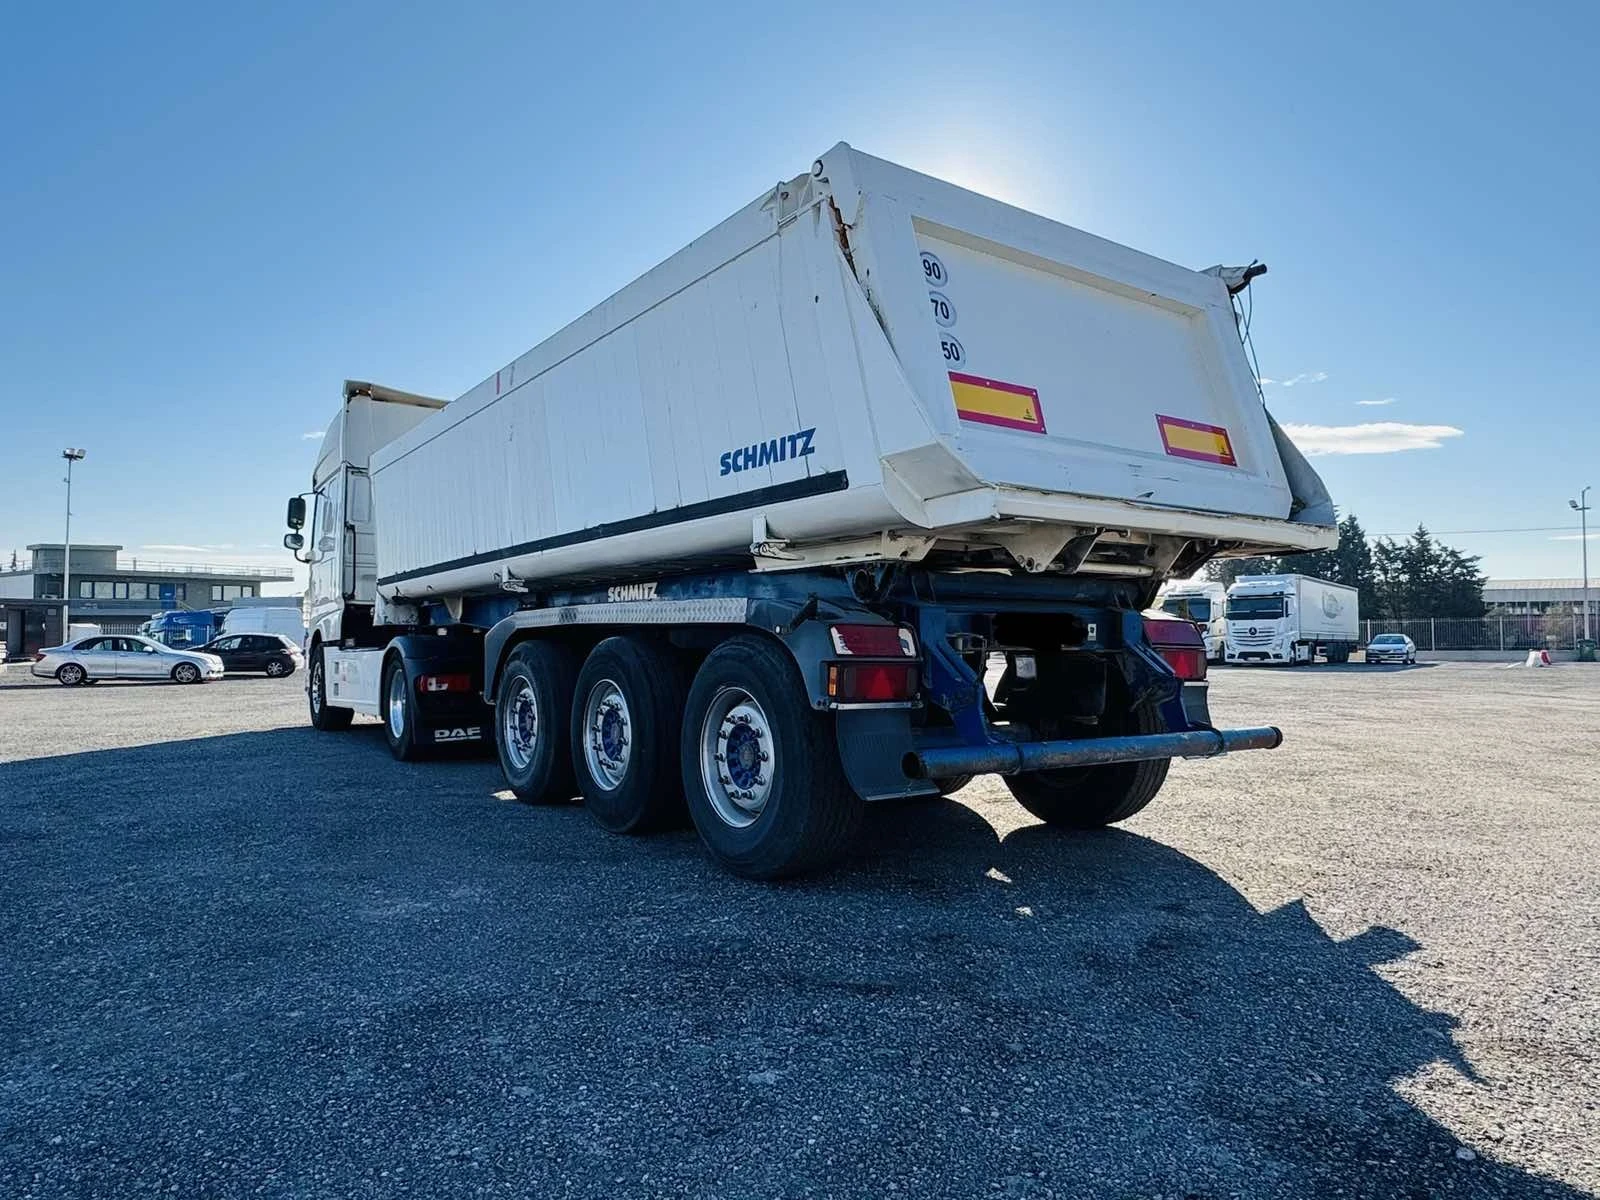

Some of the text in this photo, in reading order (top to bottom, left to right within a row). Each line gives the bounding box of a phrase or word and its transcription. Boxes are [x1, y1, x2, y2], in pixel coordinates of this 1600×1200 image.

[923, 259, 941, 280] 90
[930, 298, 949, 320] 70
[941, 341, 960, 361] 50
[720, 427, 816, 476] SCHMITZ
[607, 582, 658, 602] SCHMITZ
[434, 726, 481, 738] DAF
